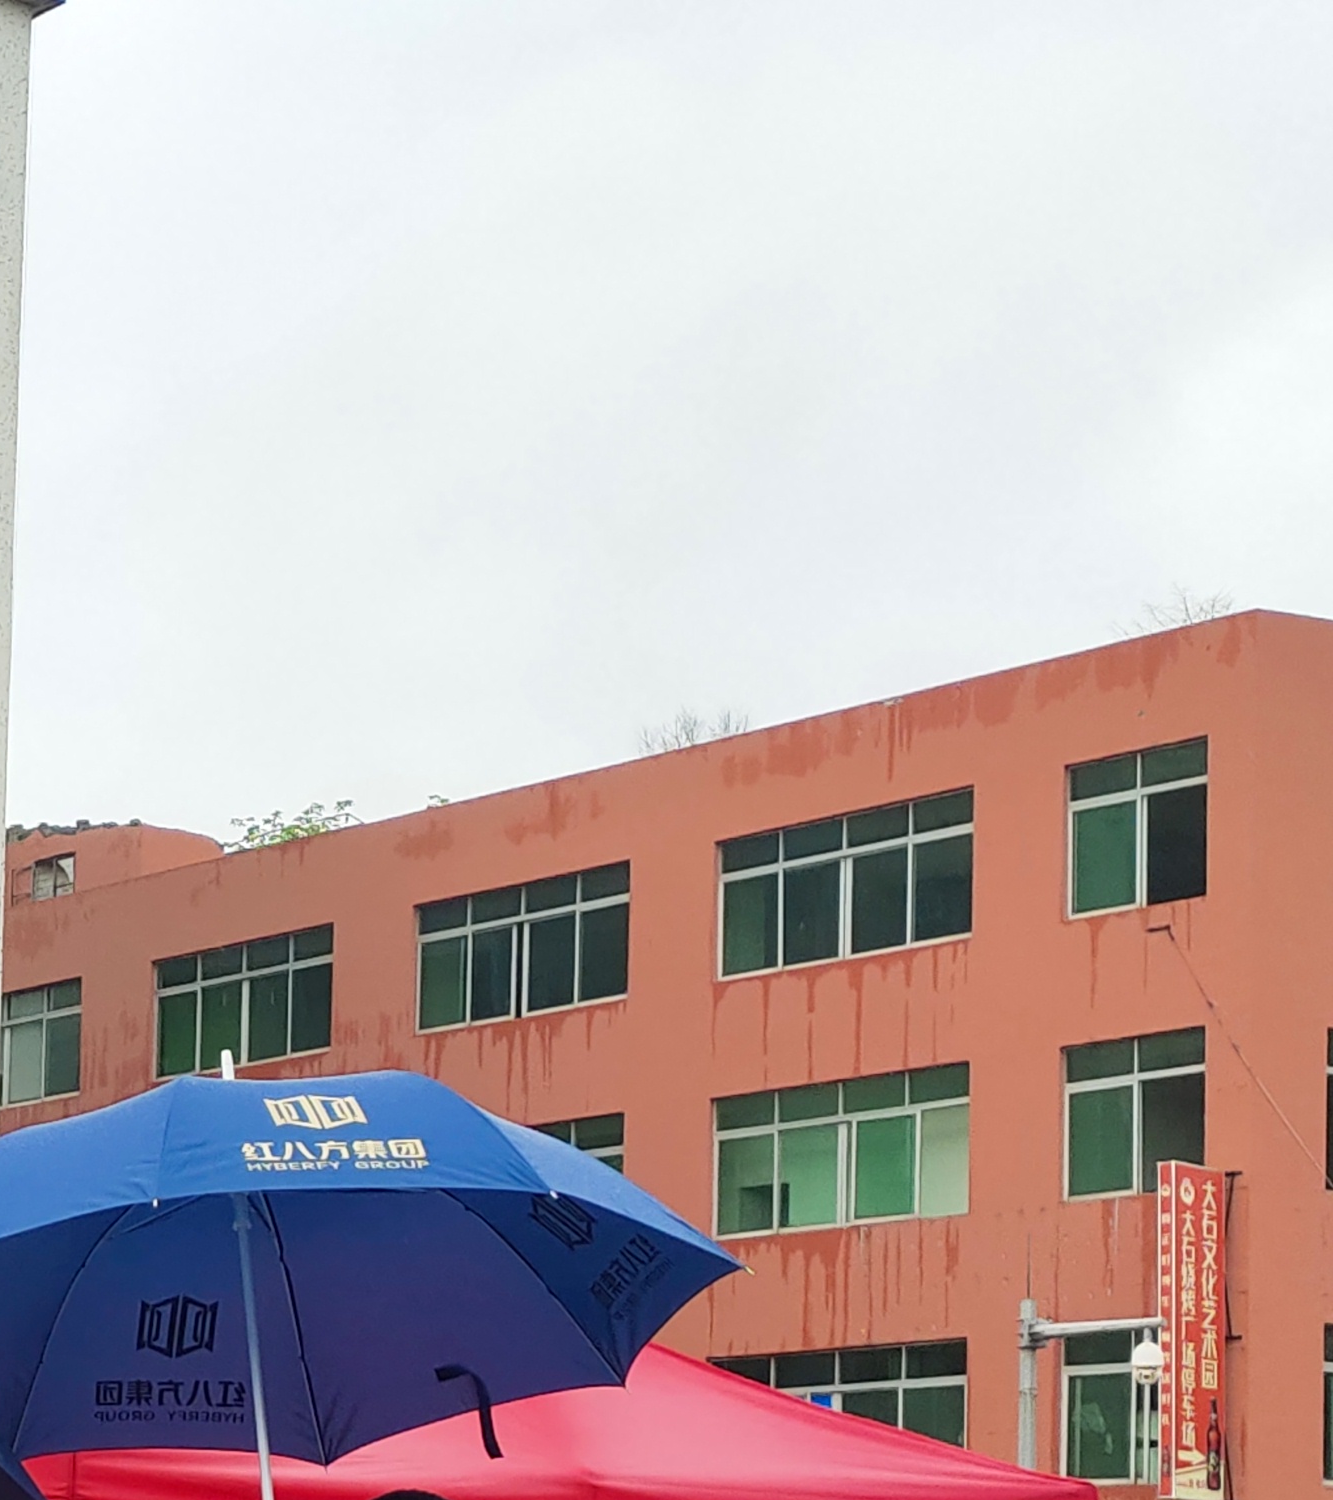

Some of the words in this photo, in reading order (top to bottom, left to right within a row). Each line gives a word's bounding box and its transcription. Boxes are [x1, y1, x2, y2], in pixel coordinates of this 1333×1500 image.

[240, 1138, 427, 1162] 红八方集团
[246, 1160, 341, 1172] HYBERFY
[353, 1159, 430, 1170] GROUP
[1201, 1179, 1219, 1390] 大石文化艺术园
